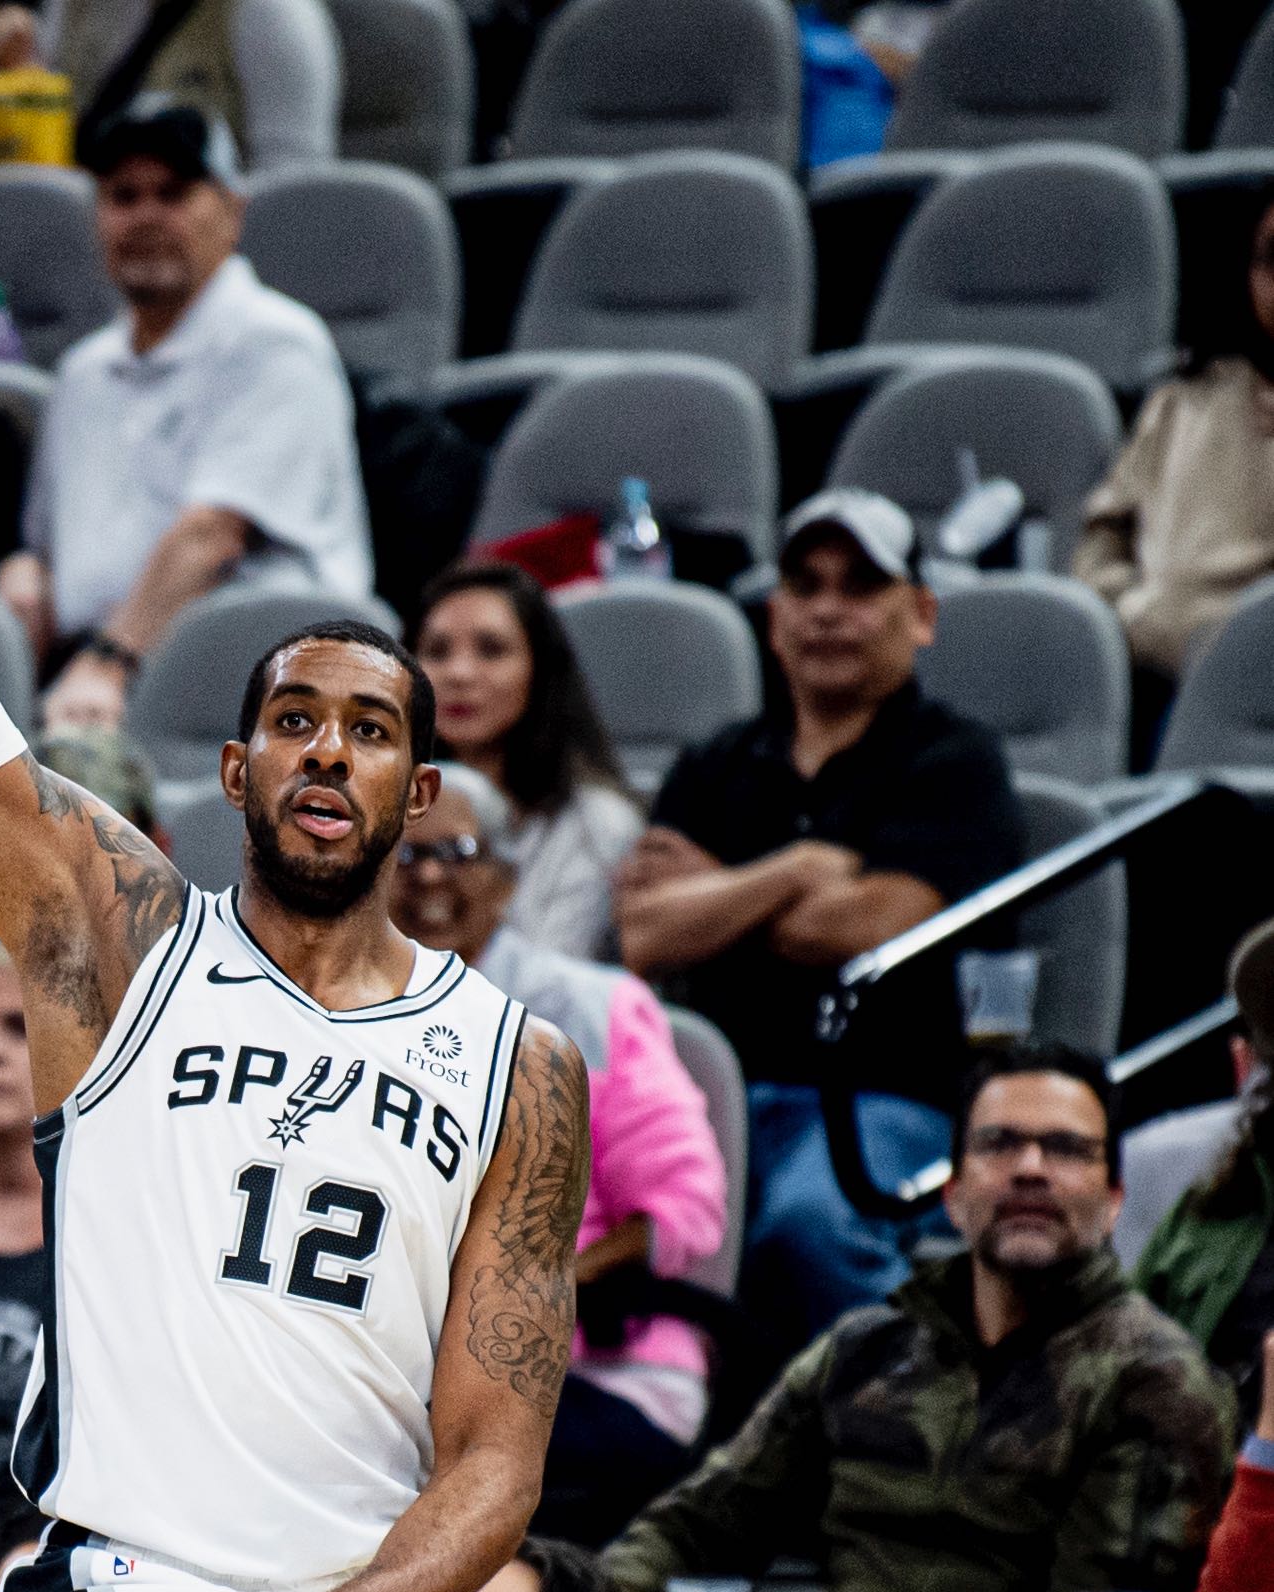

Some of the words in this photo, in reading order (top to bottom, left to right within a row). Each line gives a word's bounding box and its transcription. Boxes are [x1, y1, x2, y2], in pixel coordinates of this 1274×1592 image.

[166, 1045, 469, 1183] SPURS
[404, 1048, 472, 1089] Frost
[215, 1158, 392, 1317] 12
